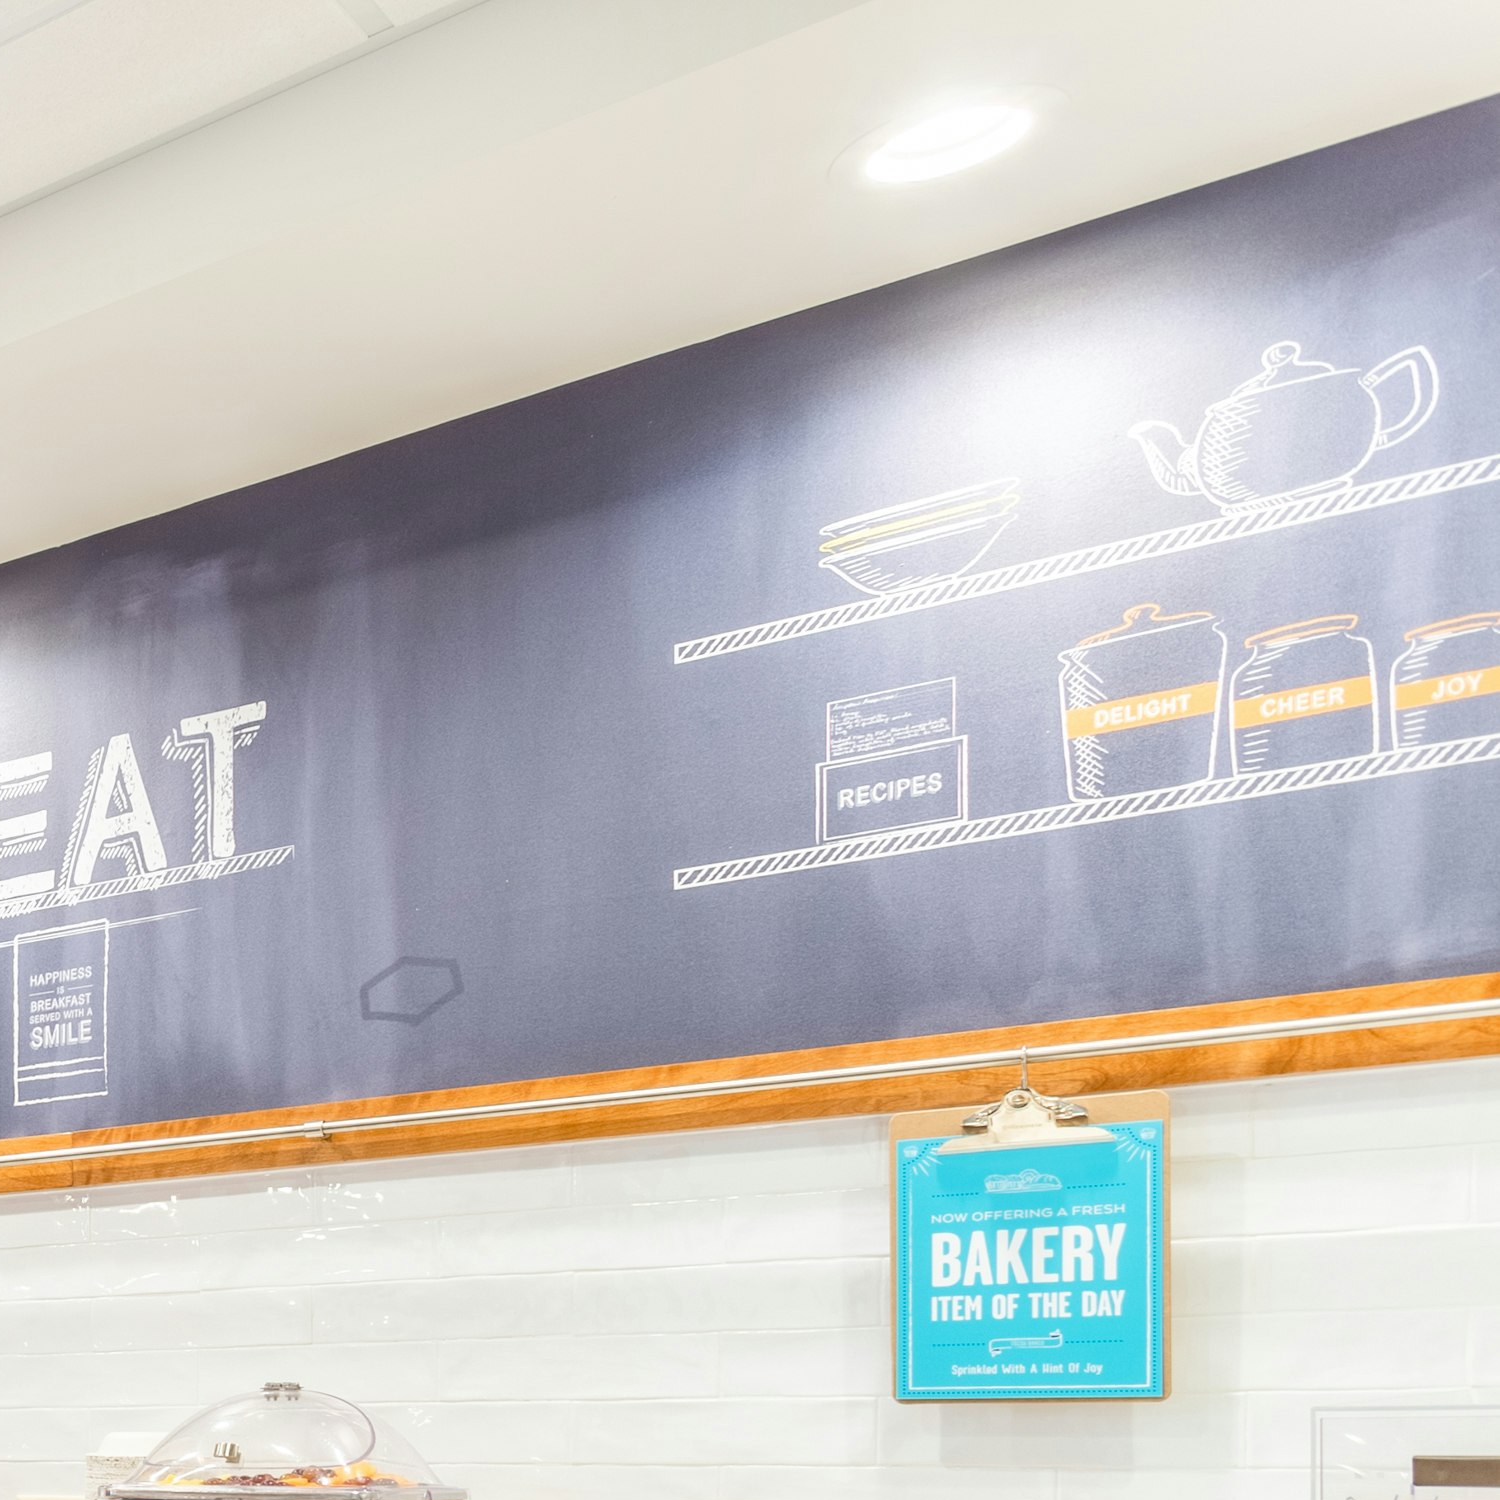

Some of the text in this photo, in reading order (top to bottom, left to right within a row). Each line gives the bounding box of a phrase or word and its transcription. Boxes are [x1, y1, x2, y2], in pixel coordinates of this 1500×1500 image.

[1431, 673, 1484, 701] JOY
[1093, 693, 1193, 728] DELIGHT
[1259, 687, 1345, 718] CHEER
[837, 772, 942, 810] RECIPES
[29, 966, 93, 987] HAPPINESS
[56, 986, 65, 995] IS
[29, 1007, 93, 1024] SERVED WITH A
[30, 993, 92, 1013] BREAKFAST
[29, 1019, 93, 1050] SMILE
[931, 1203, 1126, 1224] NOW OFFERING A FRESH
[931, 1223, 1127, 1288] BAKERY
[931, 1289, 1126, 1322] ITEM OF THE DAY
[951, 1362, 1103, 1377] Sprinkled With A Hint Of Joy
